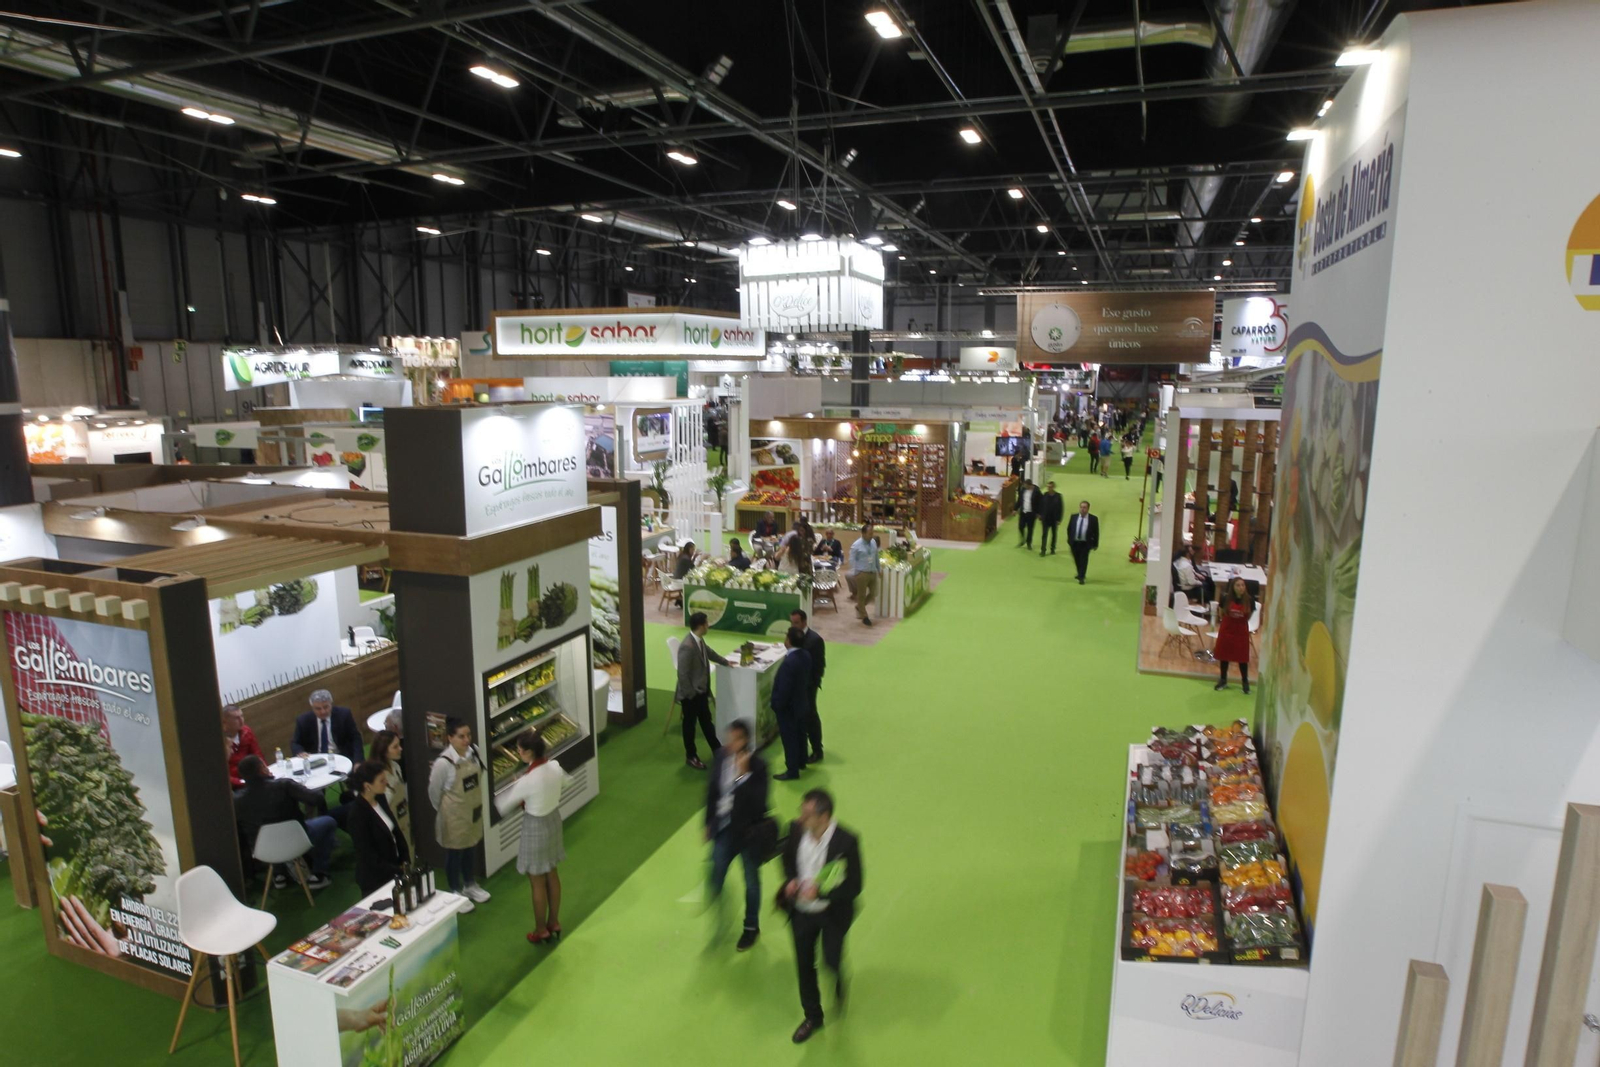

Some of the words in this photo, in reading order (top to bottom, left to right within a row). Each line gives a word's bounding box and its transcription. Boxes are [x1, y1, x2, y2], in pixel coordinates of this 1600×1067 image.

[1335, 175, 1349, 243] de
[1346, 131, 1394, 235] Almería
[1102, 307, 1121, 318] Ese
[1122, 308, 1152, 320] gusto
[1093, 324, 1113, 335] que
[1115, 324, 1131, 333] nos
[1134, 322, 1159, 333] hace
[1231, 323, 1277, 336] CAPARRÓS
[1108, 338, 1142, 349] únicos
[478, 451, 577, 491] Gallombares
[14, 634, 153, 694] Gallombares
[102, 701, 122, 716] todo
[110, 908, 121, 922] EN
[121, 897, 151, 917] AHORRO
[151, 906, 167, 924] DEL
[127, 928, 134, 942] A
[133, 932, 145, 945] LA
[144, 934, 191, 961] UTILIZACIÓN
[119, 941, 130, 954] DE
[130, 944, 158, 965] PLACAS
[158, 952, 192, 977] SOLARES
[404, 1042, 423, 1067] AGUA
[433, 1010, 457, 1040] LLUVIA
